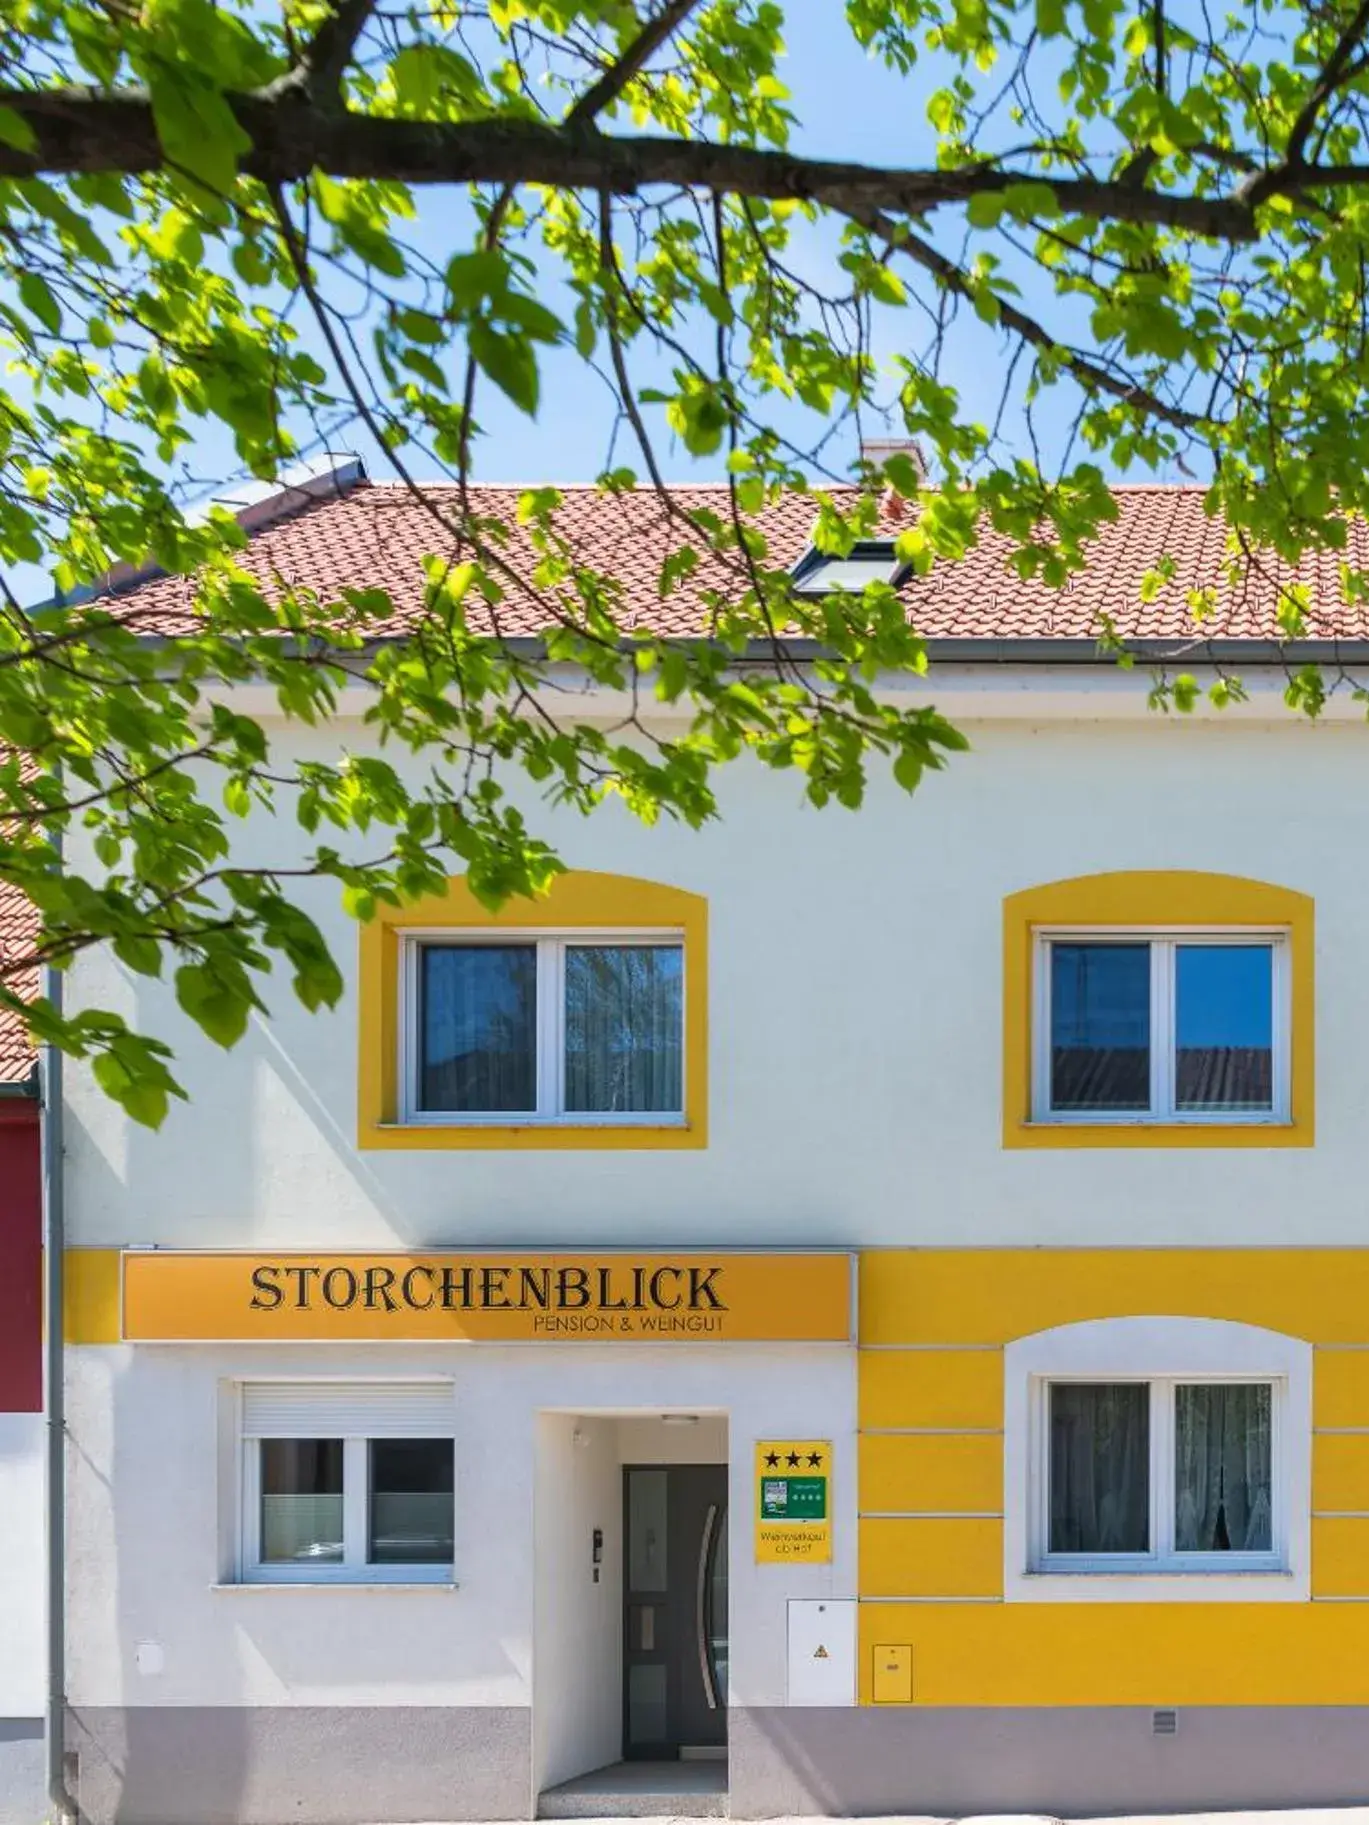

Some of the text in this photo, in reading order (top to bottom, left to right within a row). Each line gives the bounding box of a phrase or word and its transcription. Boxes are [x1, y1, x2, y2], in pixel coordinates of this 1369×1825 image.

[250, 1265, 729, 1312] STORCHENBLICK
[534, 1315, 724, 1332] PENSION & WEINGUT
